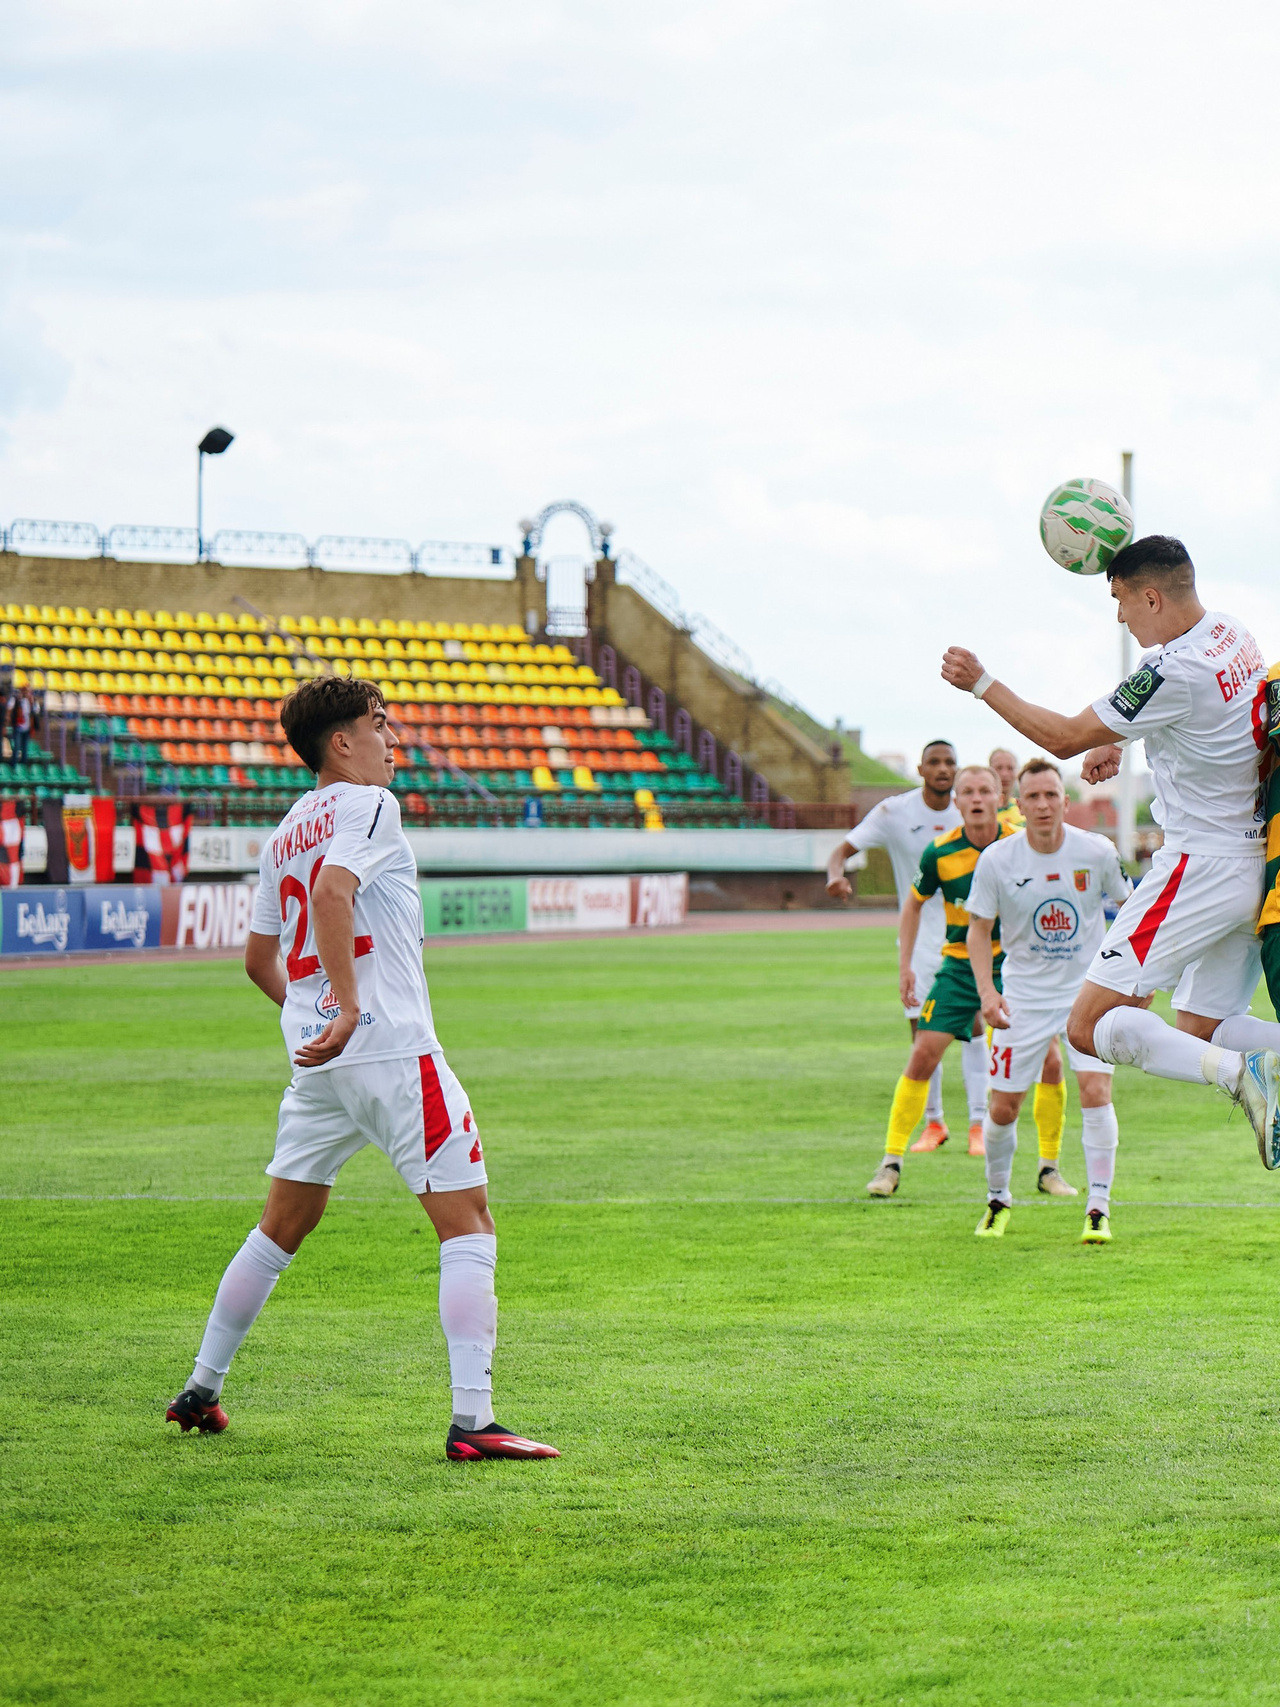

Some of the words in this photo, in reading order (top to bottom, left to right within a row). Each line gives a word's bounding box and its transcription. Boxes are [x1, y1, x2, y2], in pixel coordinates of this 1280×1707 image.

[1210, 621, 1226, 640] ЗАО
[177, 886, 262, 949] FONB
[440, 887, 511, 927] BETERA
[1046, 931, 1067, 942] ОАО
[301, 1025, 313, 1040] ОАО
[990, 1046, 1013, 1080] 31
